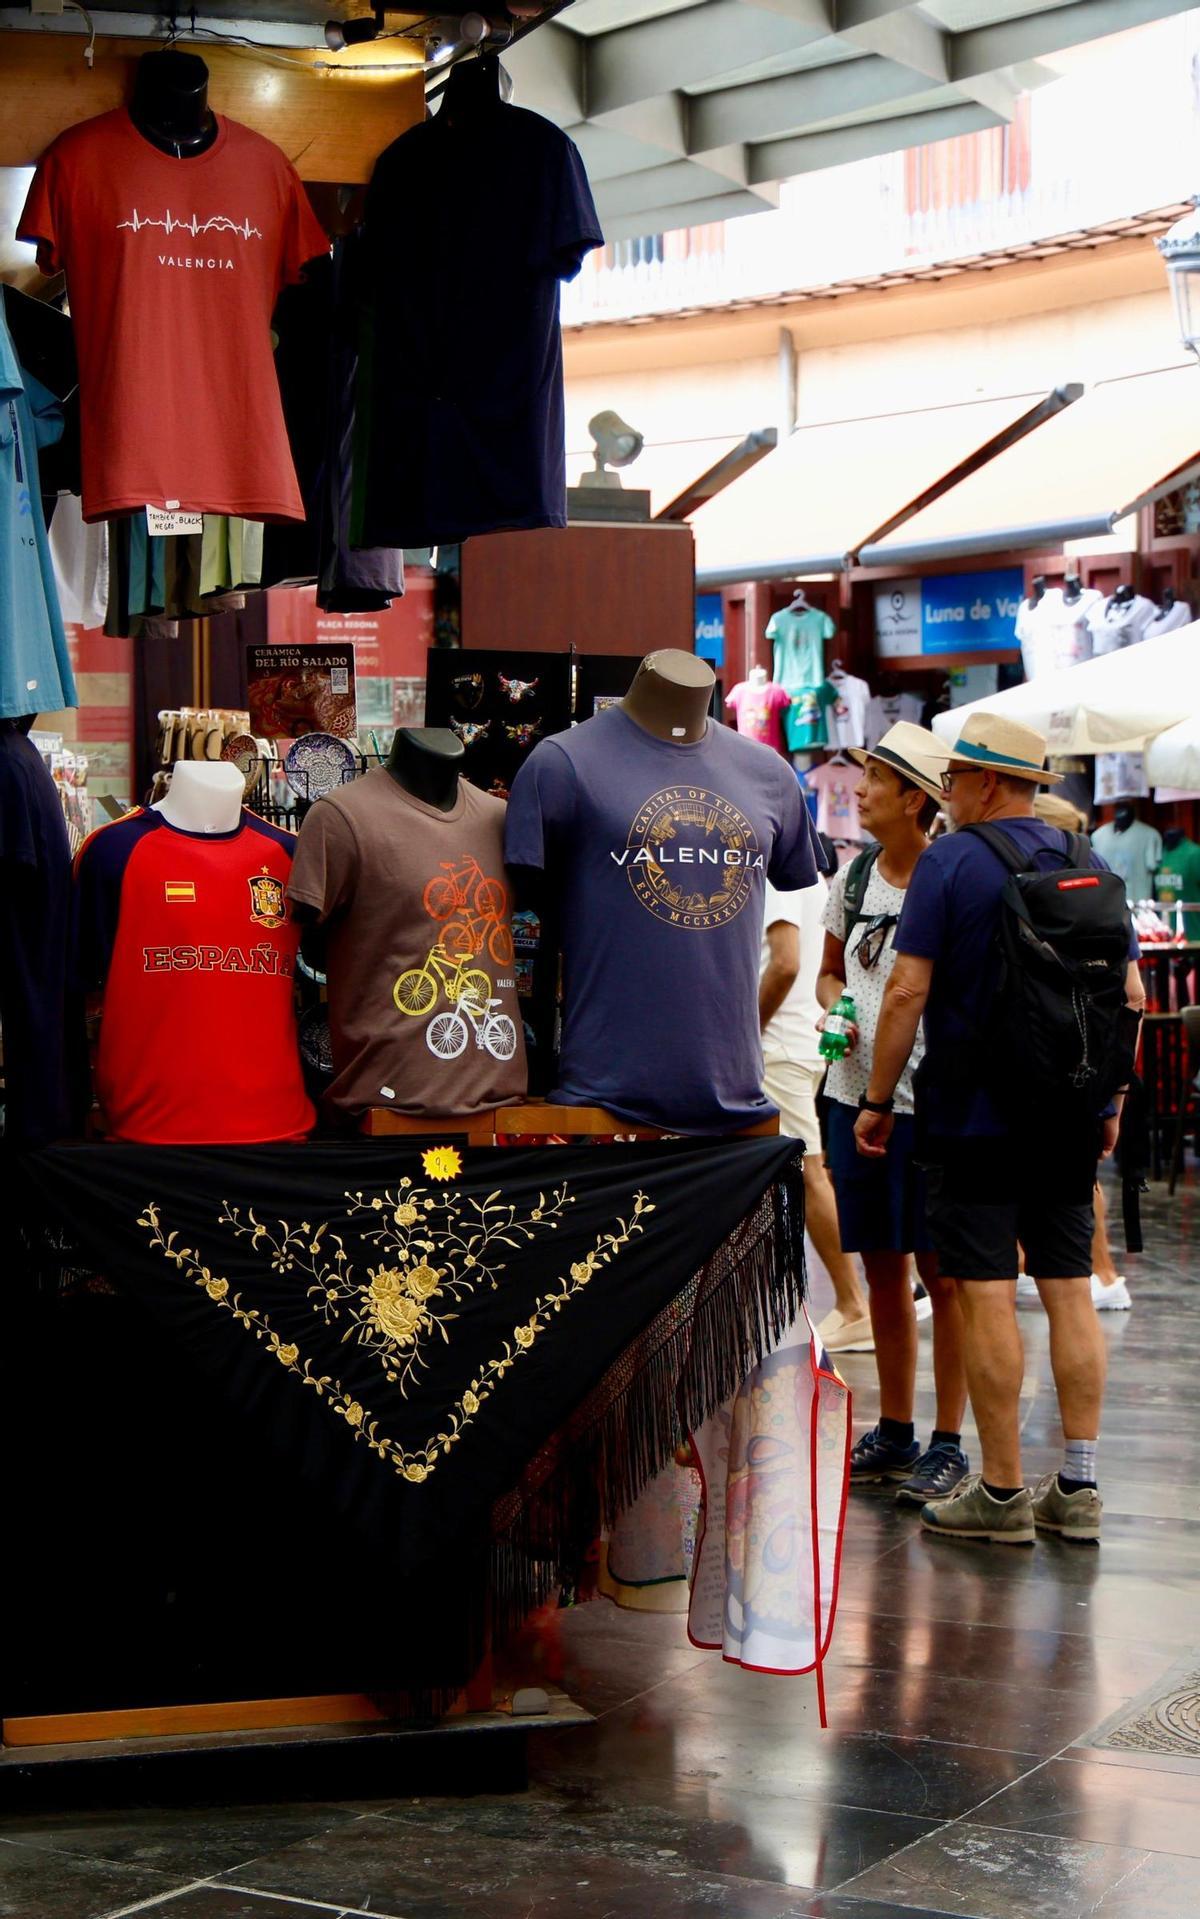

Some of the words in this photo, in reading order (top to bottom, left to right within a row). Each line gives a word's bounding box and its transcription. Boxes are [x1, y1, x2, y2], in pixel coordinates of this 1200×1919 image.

[158, 255, 234, 269] VALENCIA
[924, 604, 965, 624] Luna
[970, 598, 990, 619] de
[255, 658, 278, 668] DEL
[302, 657, 348, 667] SALADO
[636, 789, 681, 834] CAPITAL
[688, 789, 706, 801] OF
[714, 798, 752, 838] TURIA
[610, 846, 765, 870] VALENCIA
[636, 881, 661, 912] EST.
